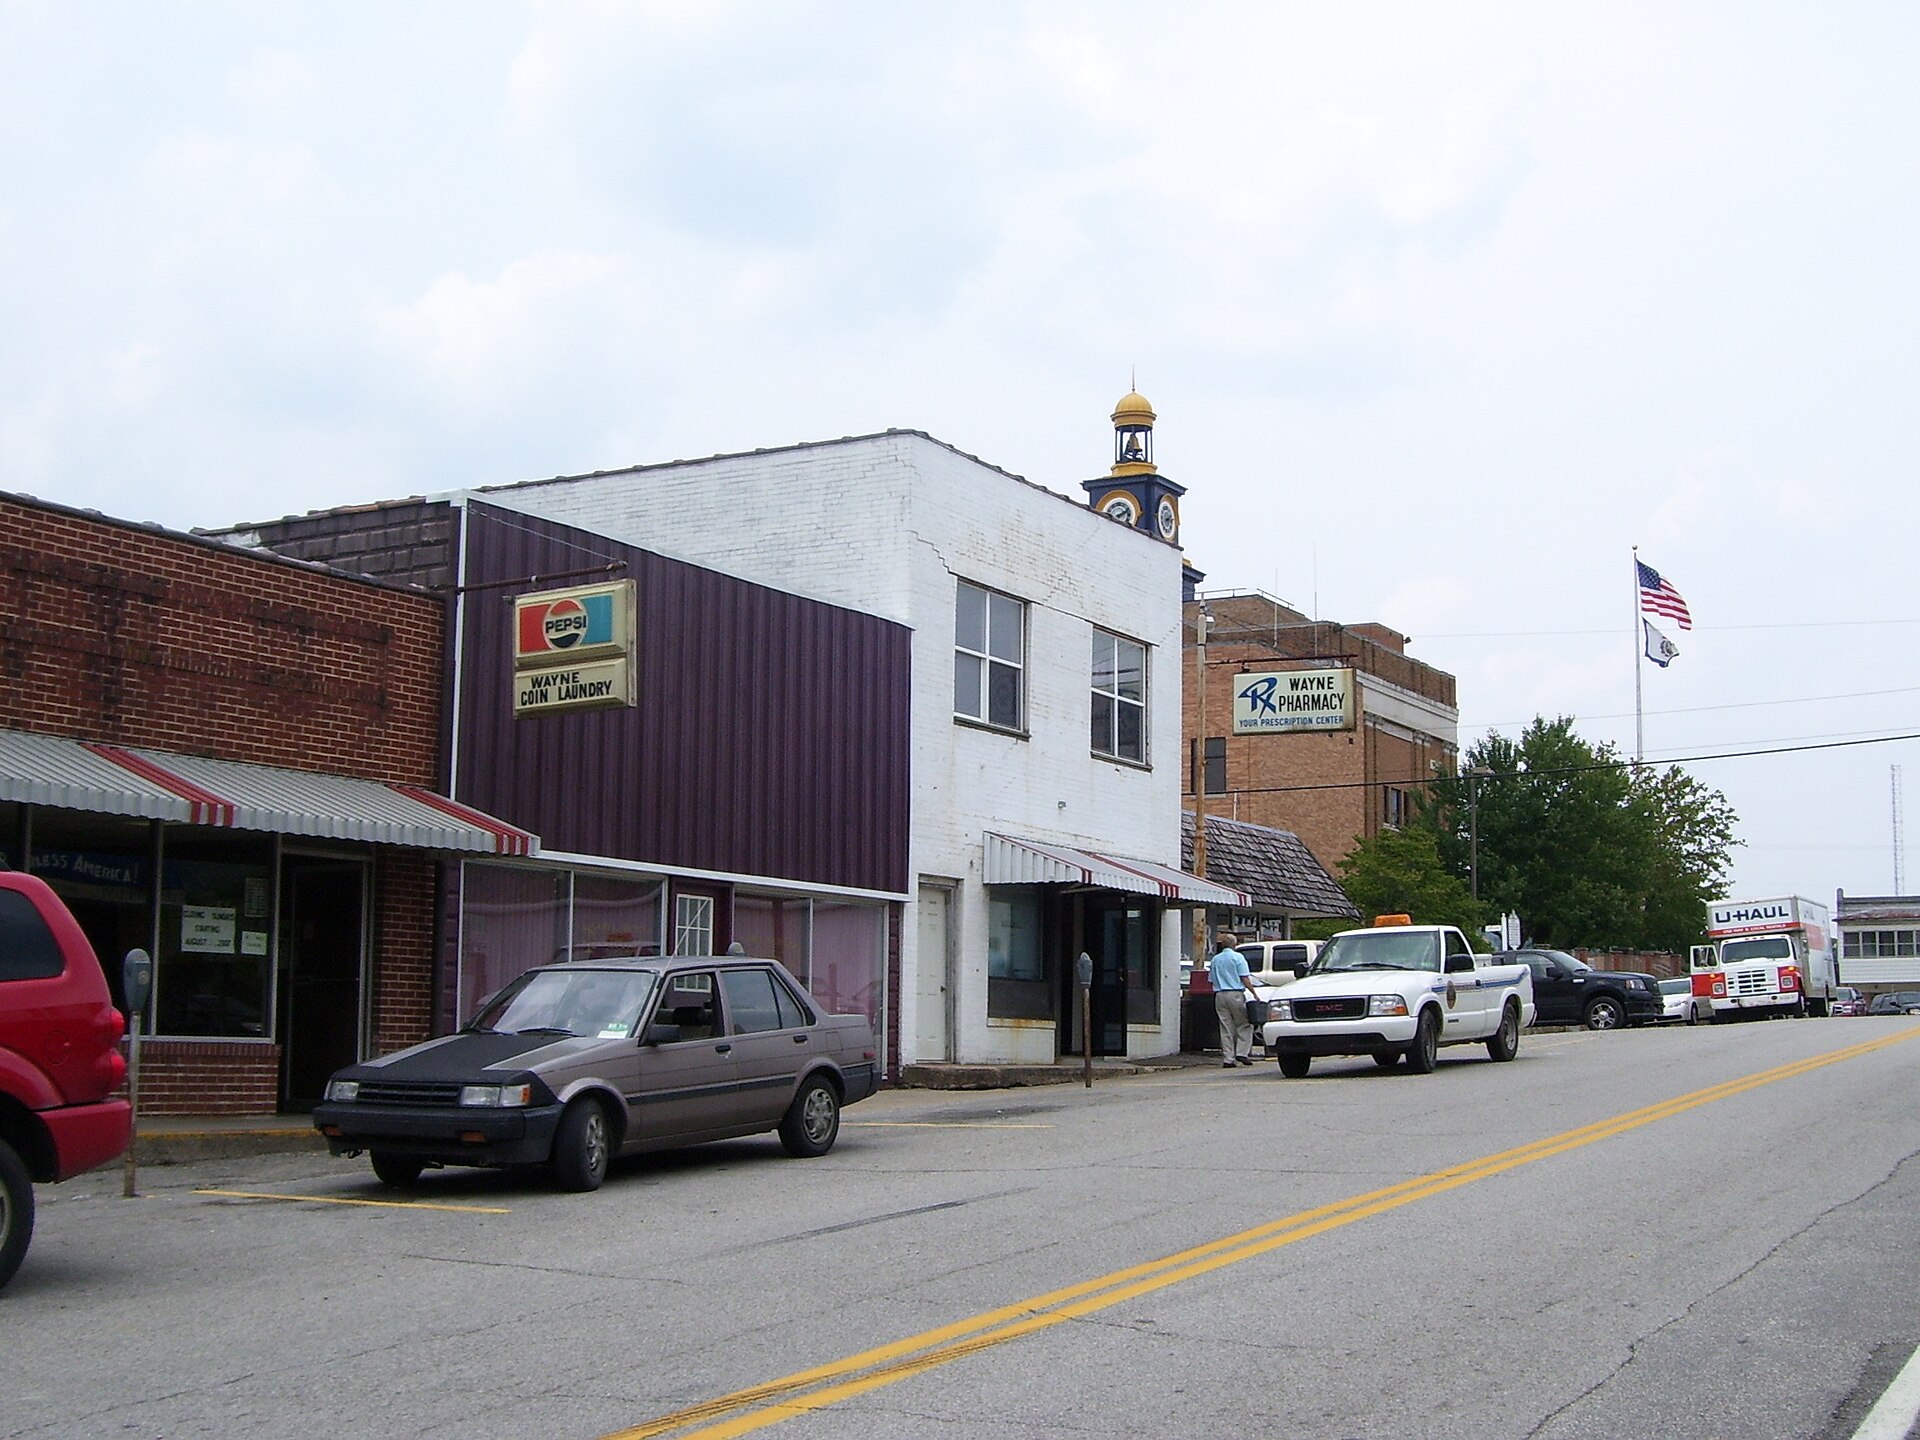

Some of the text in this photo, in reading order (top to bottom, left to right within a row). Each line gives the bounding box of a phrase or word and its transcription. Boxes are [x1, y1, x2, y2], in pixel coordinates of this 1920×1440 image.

[545, 615, 587, 634] PEPSI
[531, 672, 580, 690] WAYNE
[1289, 676, 1334, 691] WAYNE
[520, 680, 613, 707] COIN LAUNDRY
[1278, 692, 1345, 712] PHARMACY
[1239, 715, 1344, 728] YOUR PRESCRIPTION CENTER
[32, 854, 68, 868] LESS
[1715, 905, 1789, 924] U-HAUL
